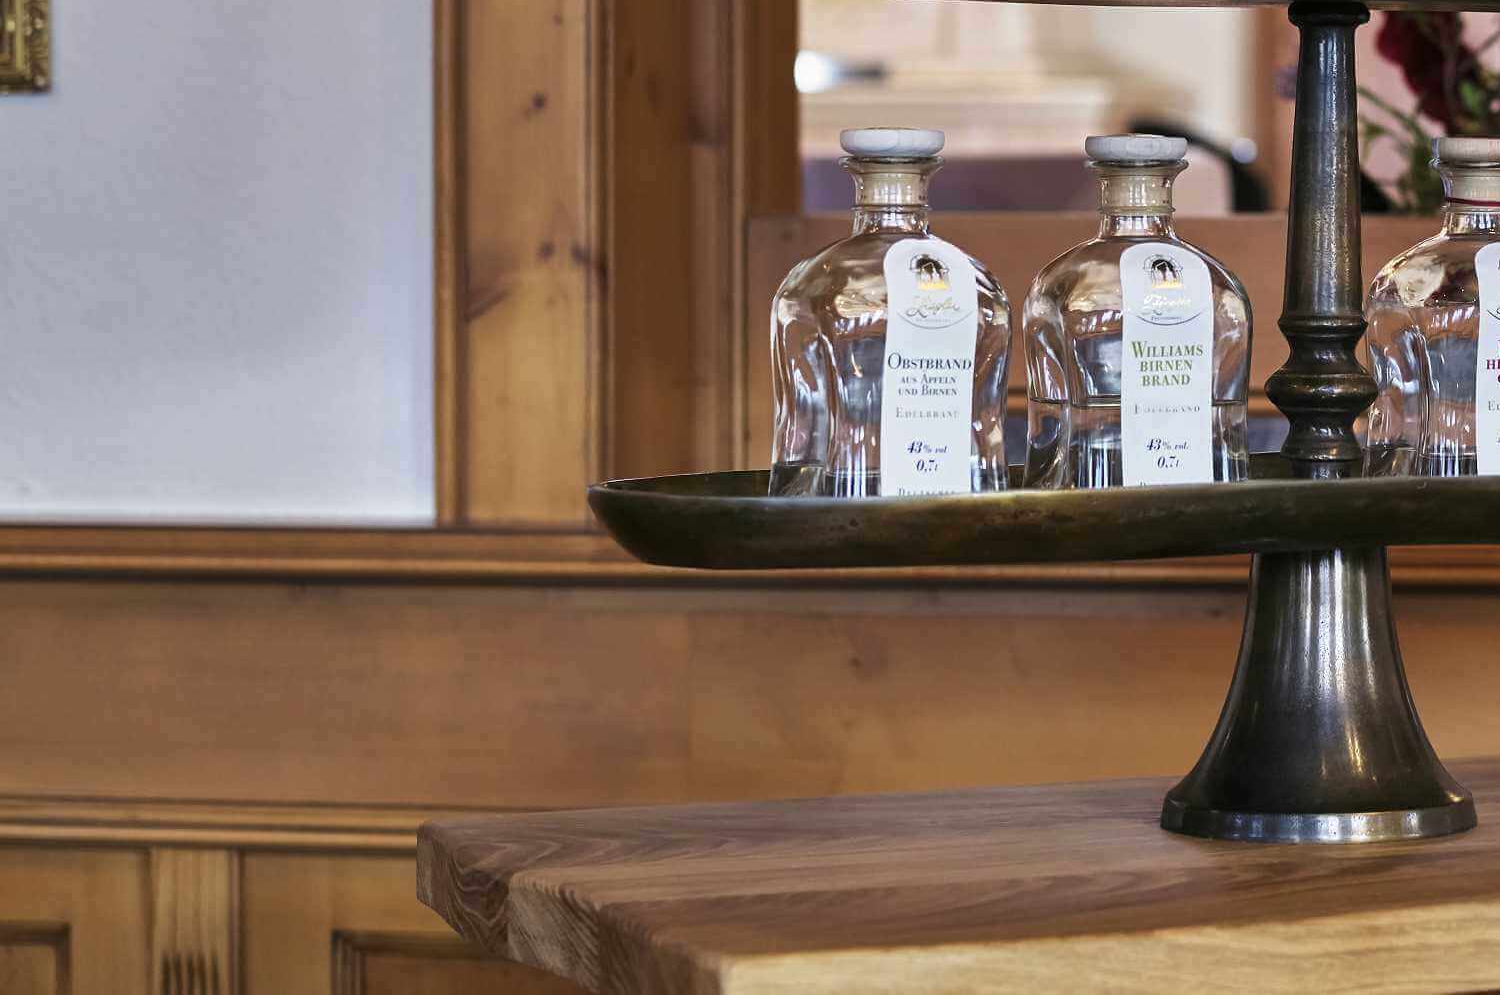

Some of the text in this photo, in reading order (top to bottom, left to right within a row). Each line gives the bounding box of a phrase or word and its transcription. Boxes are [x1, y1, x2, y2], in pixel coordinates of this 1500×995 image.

[1131, 341, 1204, 358] WILLIAMS
[888, 352, 972, 370] OBSTBRAND
[1140, 360, 1193, 373] BIRNEN
[901, 376, 917, 385] AUS
[1142, 374, 1190, 387] BRAND
[898, 385, 957, 397] UND BIRNEN
[907, 441, 932, 454] 43%
[1147, 438, 1172, 451] 43%
